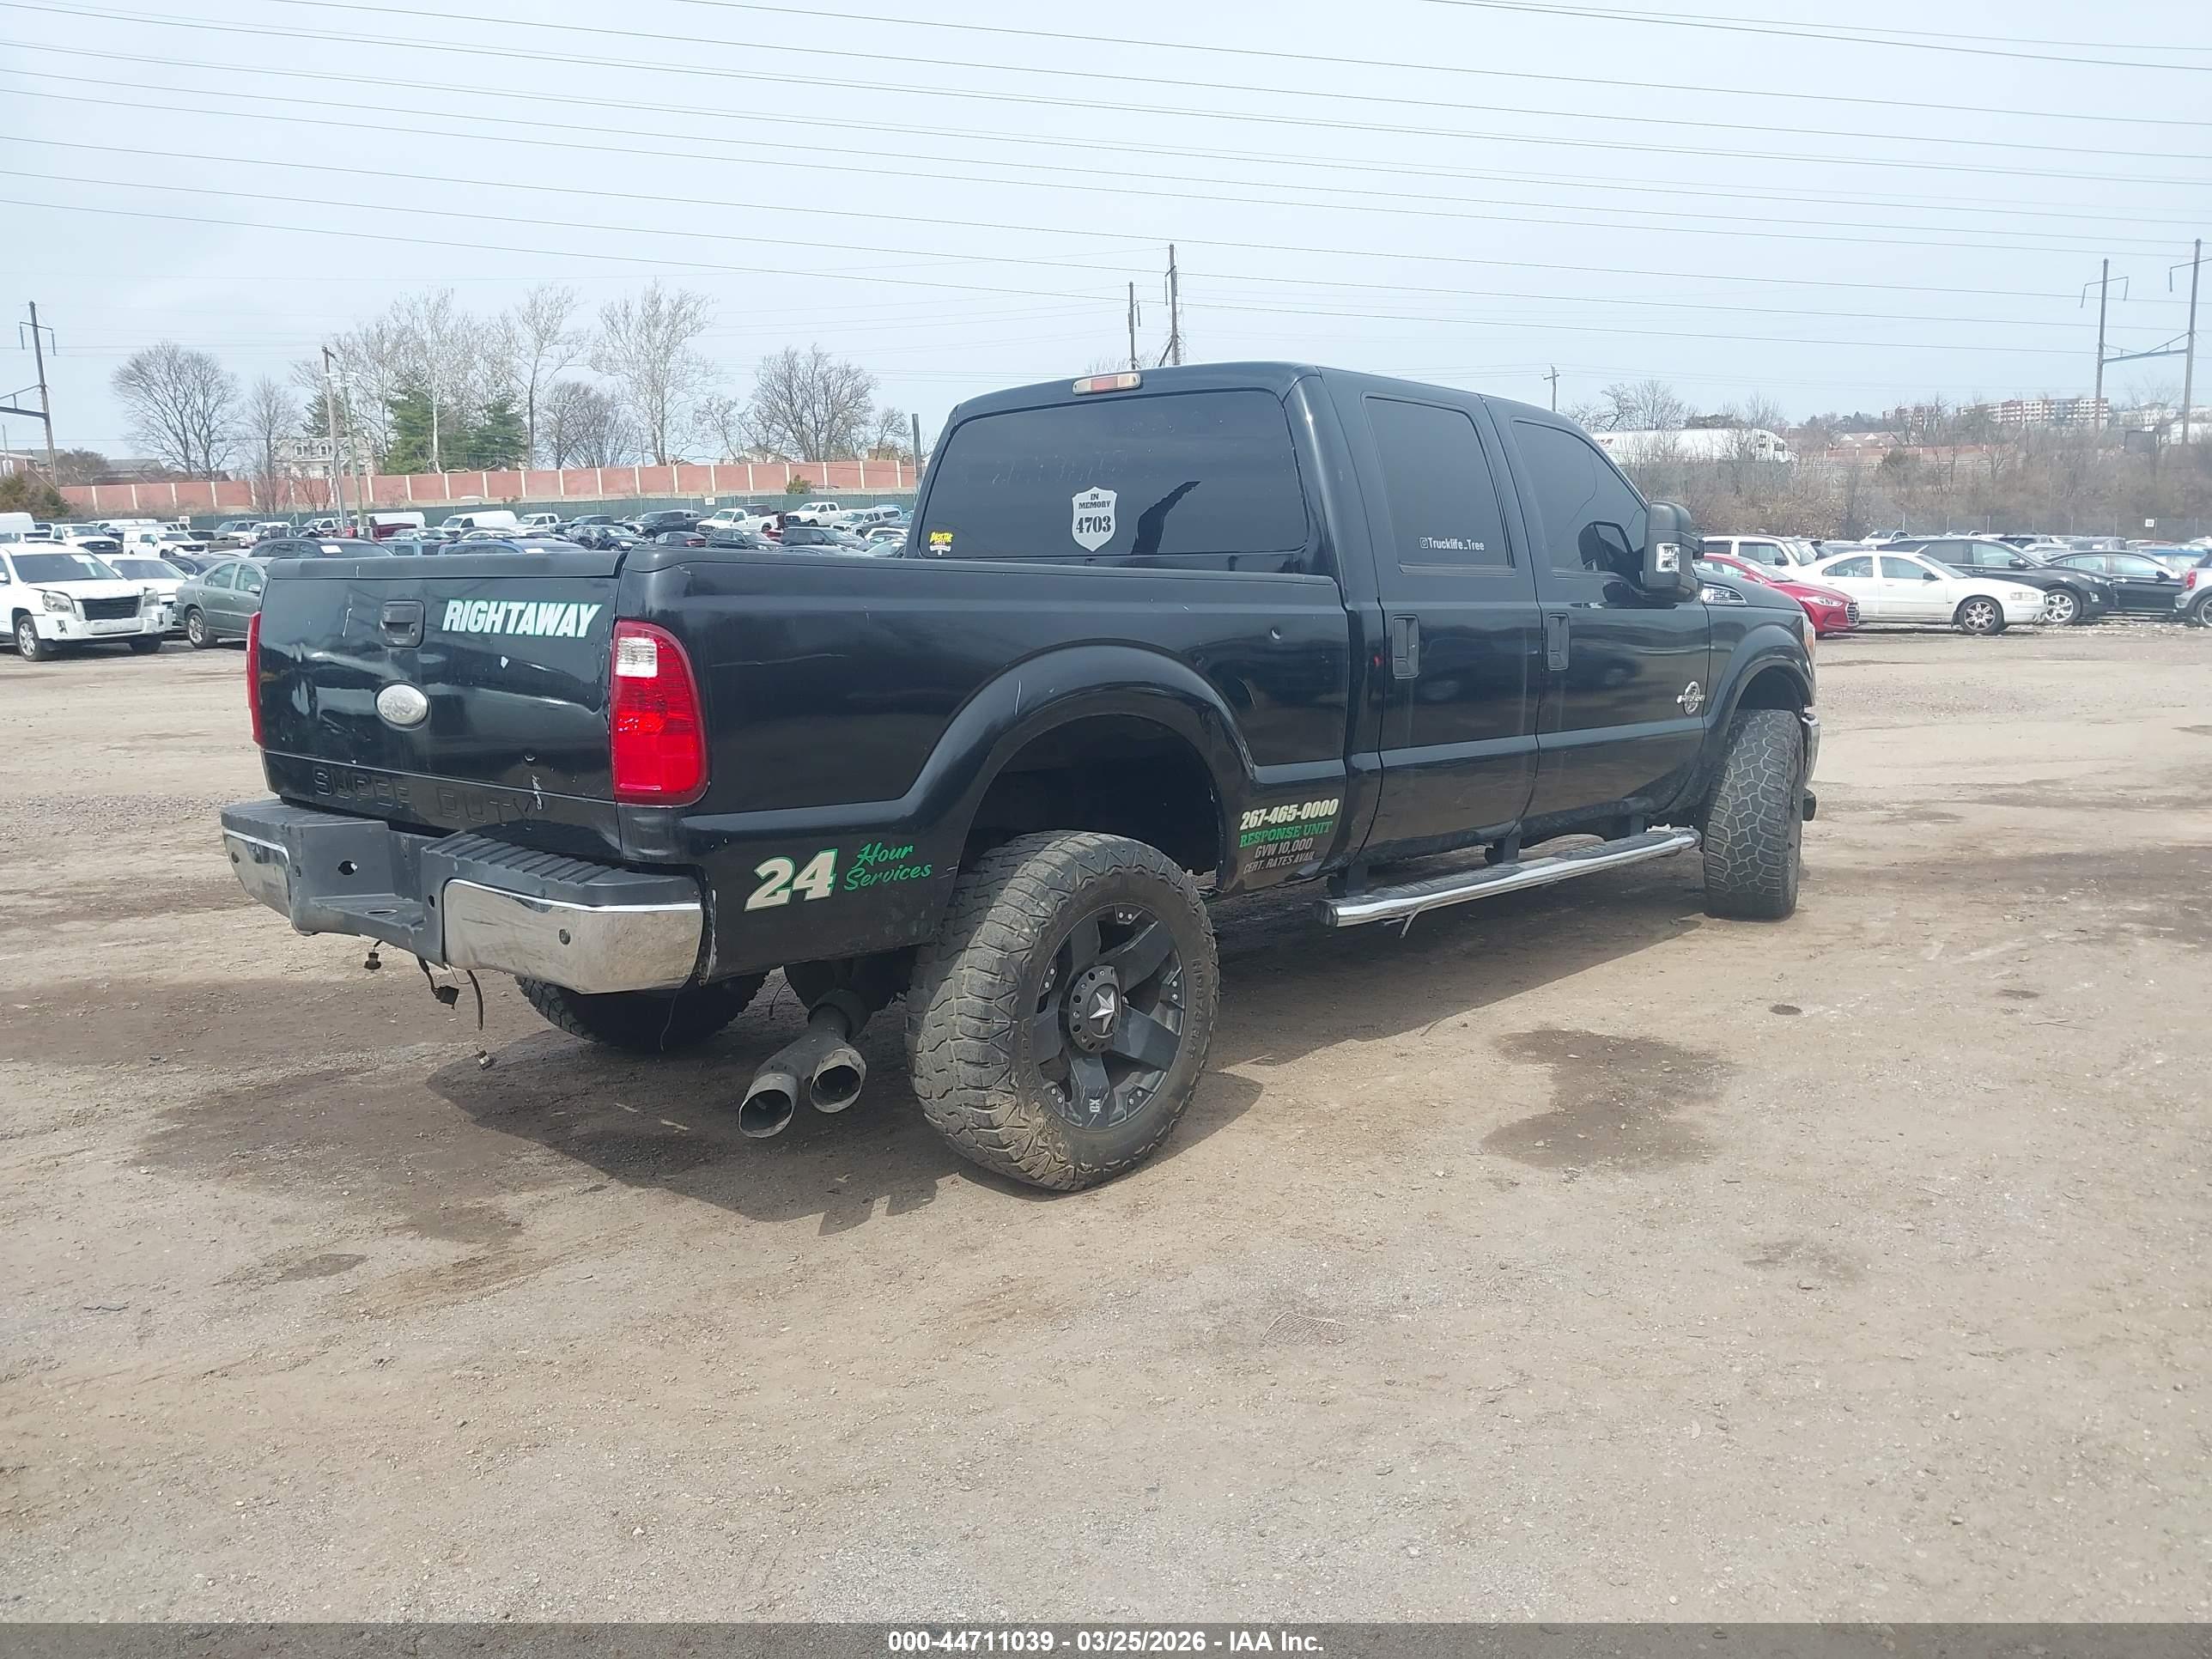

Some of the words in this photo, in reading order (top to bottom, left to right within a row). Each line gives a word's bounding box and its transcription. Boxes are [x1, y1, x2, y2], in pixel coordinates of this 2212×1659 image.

[1079, 501, 1111, 509] MEMORY
[1076, 515, 1112, 534] 4703
[441, 599, 603, 639] RIGHTAWAY
[1239, 799, 1340, 831] 267-465-0000
[1239, 825, 1300, 848] RESPONSE
[1302, 821, 1333, 836] UNIT
[851, 842, 914, 870] Hour
[1255, 844, 1277, 859] GVW
[1278, 838, 1313, 855] 10,000
[1267, 855, 1294, 868] RATES
[744, 848, 838, 912] 24
[843, 863, 933, 891] Services
